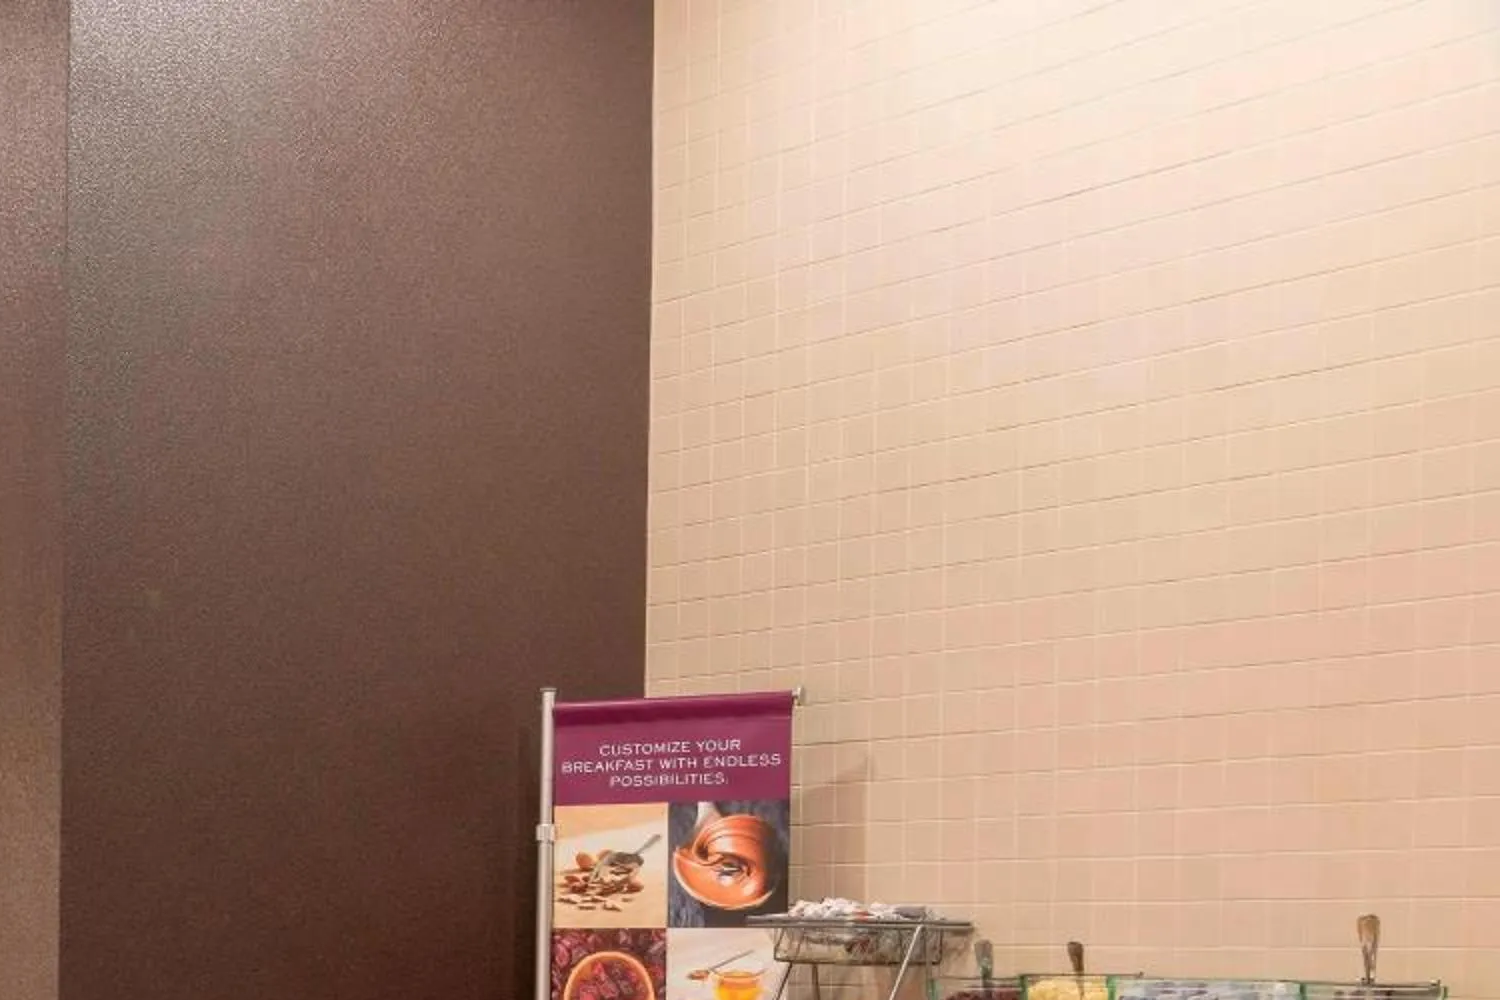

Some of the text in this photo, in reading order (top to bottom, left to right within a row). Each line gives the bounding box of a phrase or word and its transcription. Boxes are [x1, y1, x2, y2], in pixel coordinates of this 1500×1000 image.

[599, 739, 741, 757] CUSTOMIZE YOUR
[561, 753, 781, 774] BREAKFAST WITH ENDLESS
